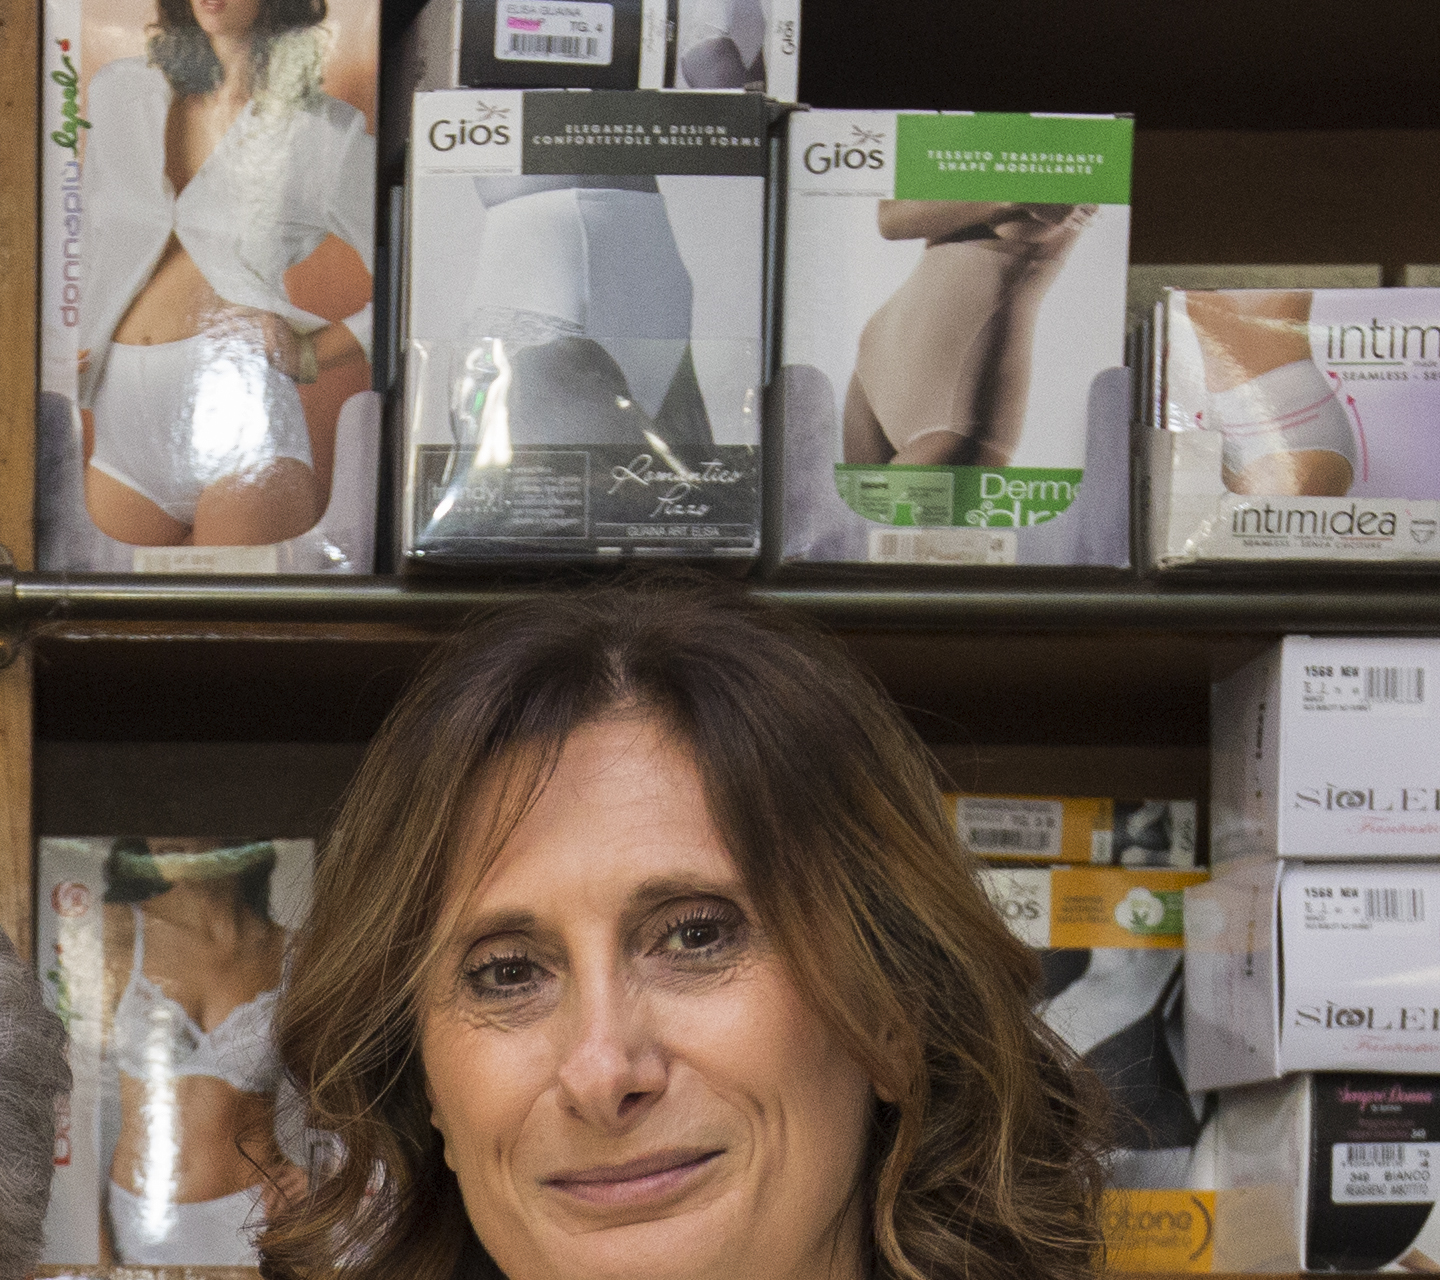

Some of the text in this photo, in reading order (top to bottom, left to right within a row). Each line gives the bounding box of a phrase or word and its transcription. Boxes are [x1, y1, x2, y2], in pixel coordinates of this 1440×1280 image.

[429, 119, 510, 151] Gios
[710, 136, 762, 147] FORME
[804, 143, 884, 175] Gios
[1002, 152, 1104, 163] TRASPIRANTE
[1342, 371, 1409, 381] SEAMLESS
[1232, 504, 1397, 537] intimidea
